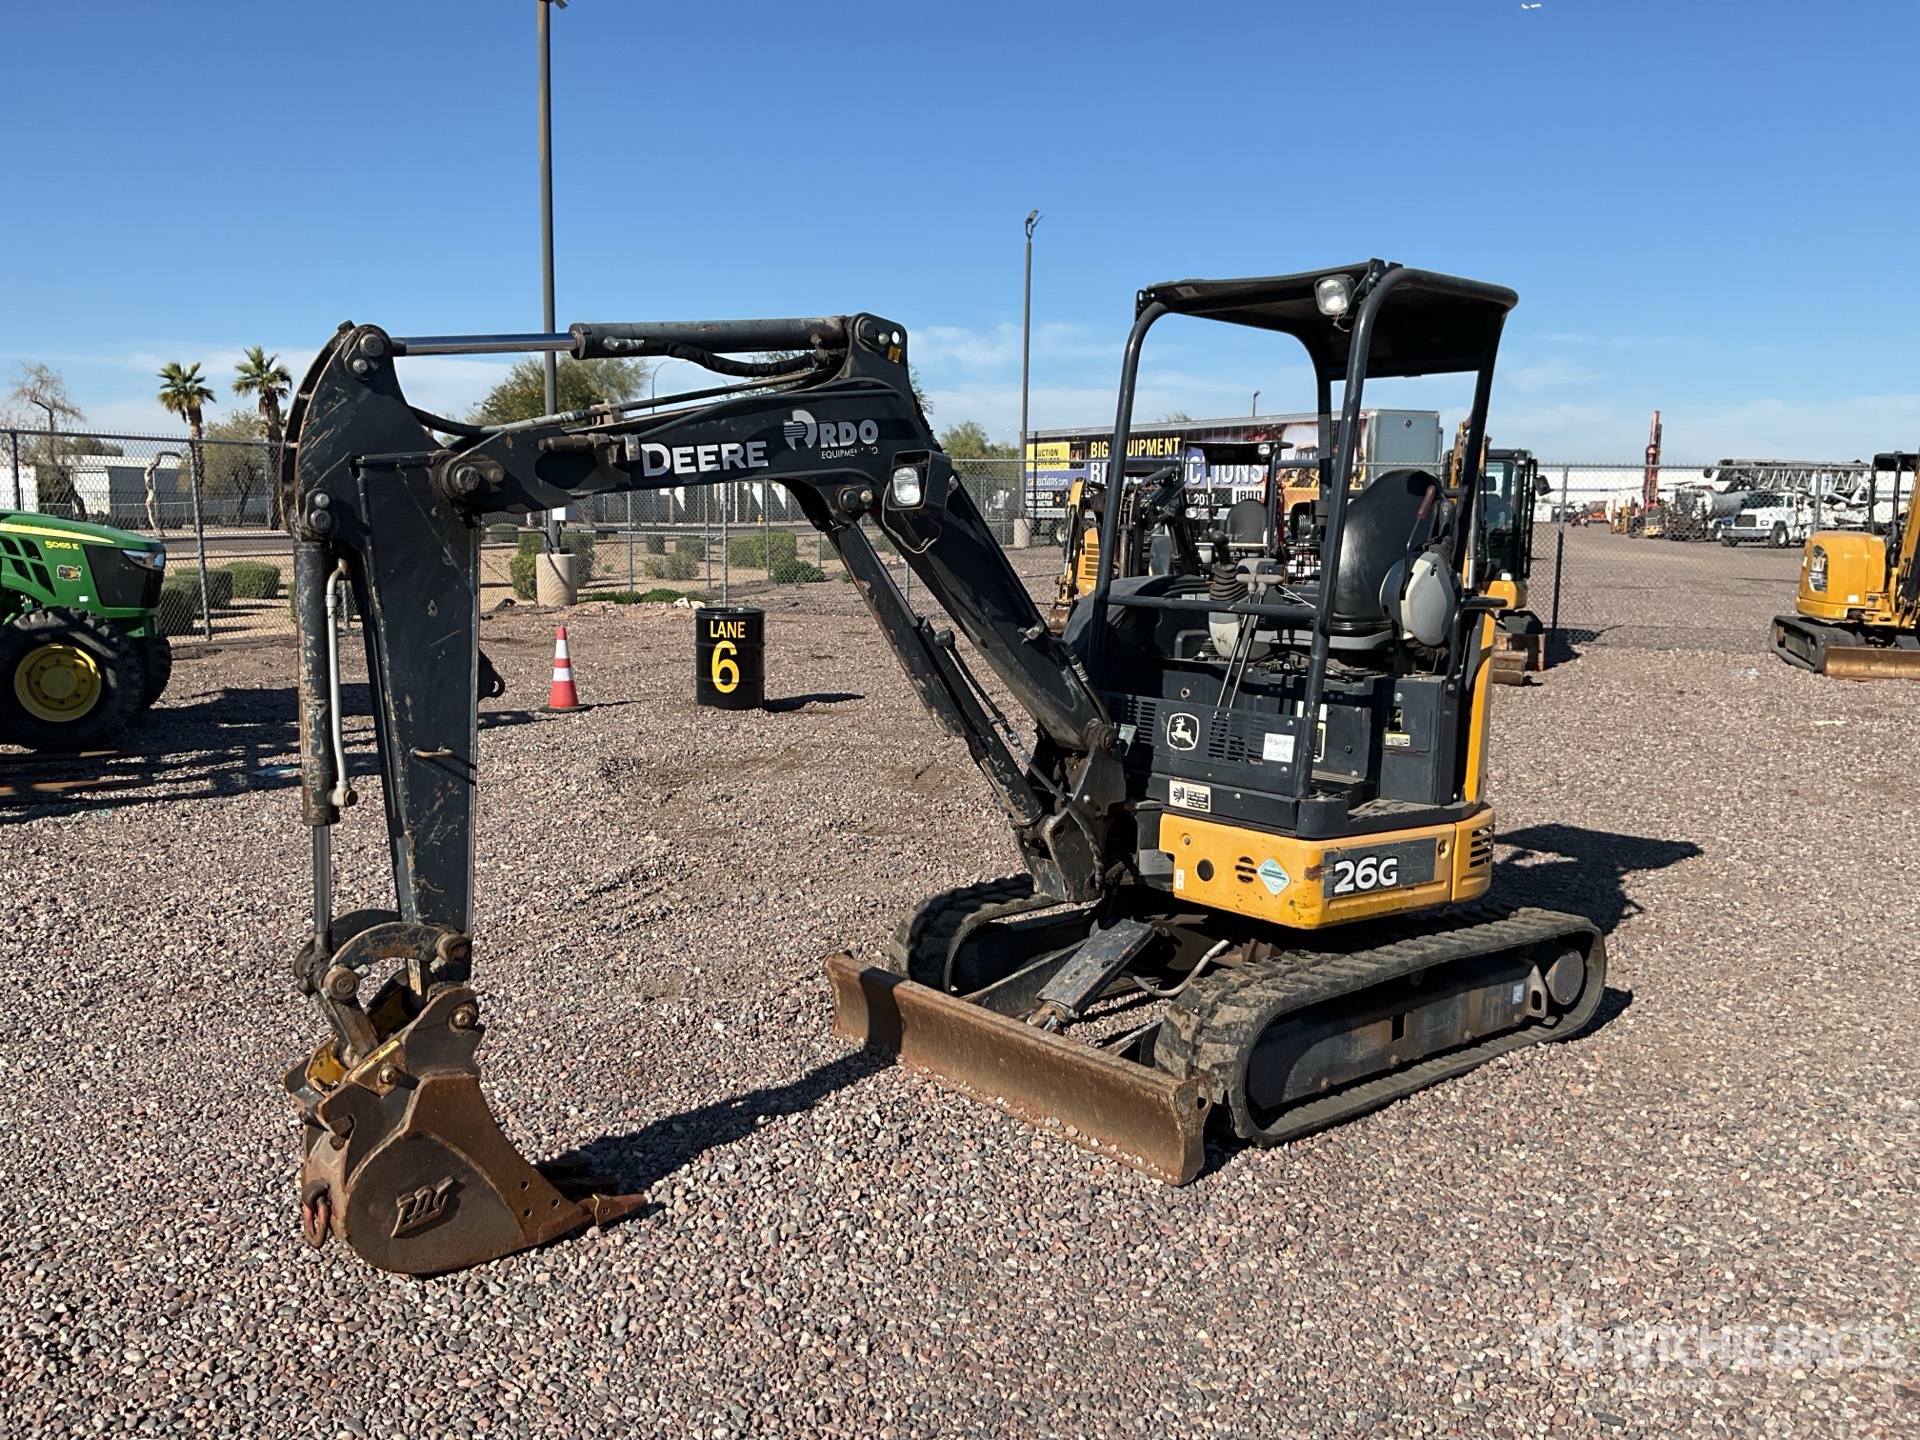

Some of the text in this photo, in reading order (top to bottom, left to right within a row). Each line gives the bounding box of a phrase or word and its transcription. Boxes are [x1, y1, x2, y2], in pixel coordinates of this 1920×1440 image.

[819, 419, 879, 448] RDO
[640, 441, 769, 477] DEERE
[821, 448, 864, 460] EQUIPME
[1035, 449, 1059, 457] UCTION
[1090, 437, 1181, 458] BIG UIPMENT
[709, 620, 746, 638] LANE
[711, 640, 740, 693] 6
[1333, 856, 1398, 893] 26G
